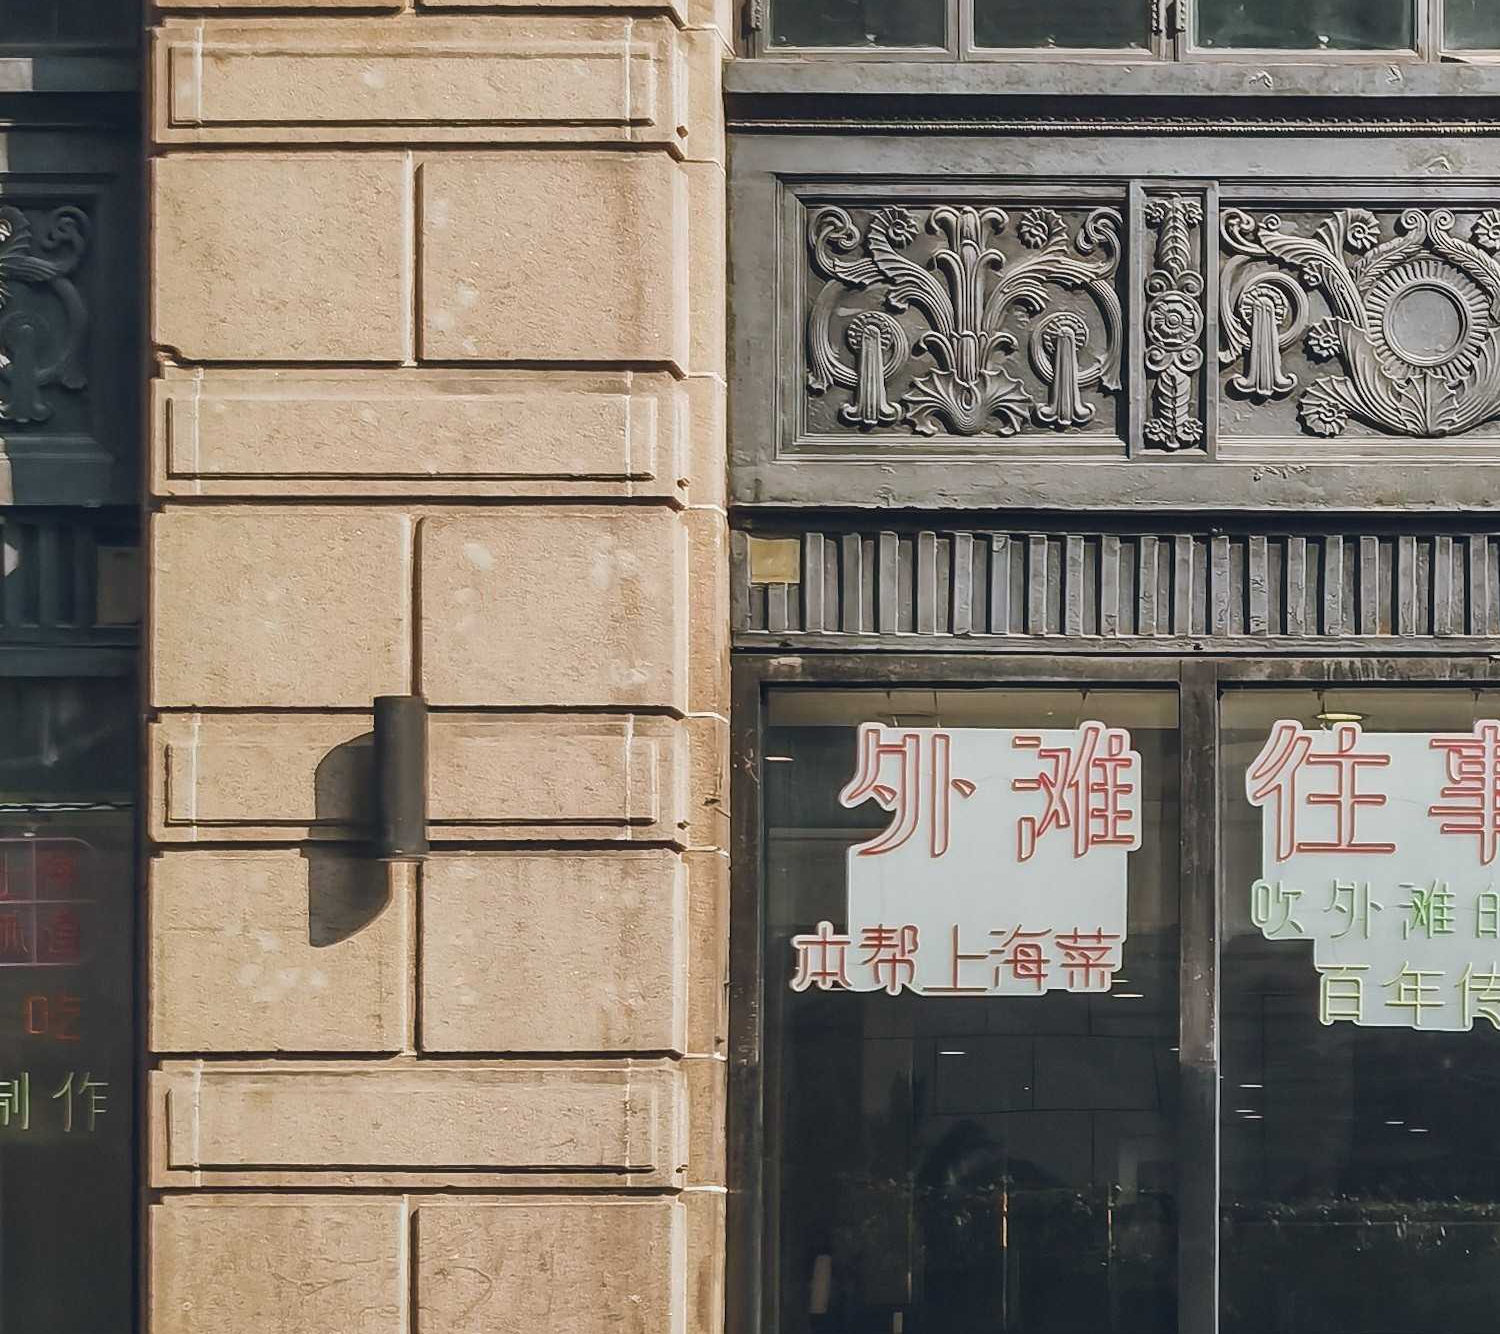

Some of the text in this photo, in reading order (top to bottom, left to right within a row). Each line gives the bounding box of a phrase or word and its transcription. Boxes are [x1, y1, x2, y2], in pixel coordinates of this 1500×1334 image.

[847, 726, 1137, 863] 外滩
[790, 923, 1123, 994] 本帮上海菜
